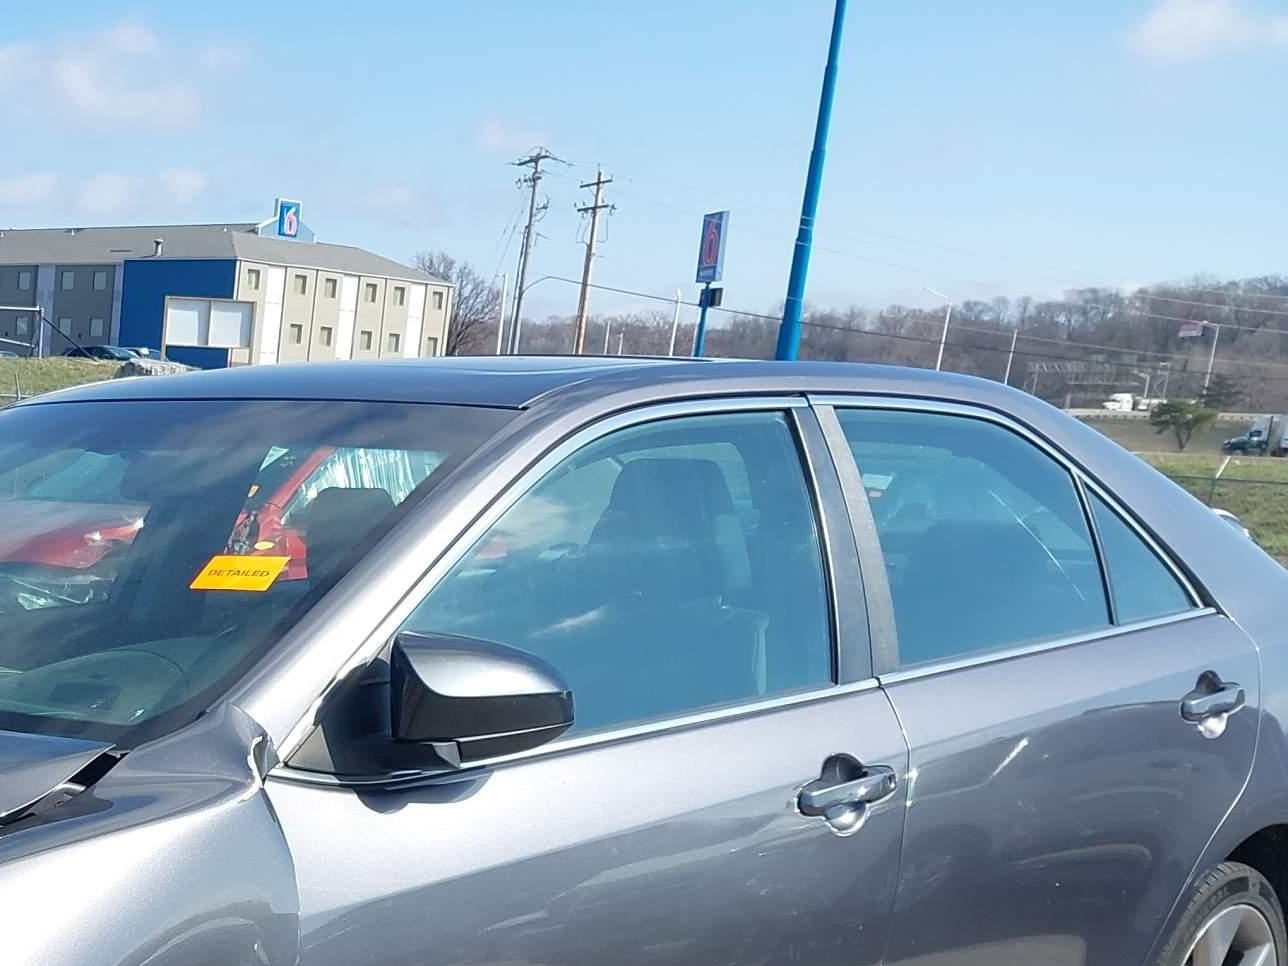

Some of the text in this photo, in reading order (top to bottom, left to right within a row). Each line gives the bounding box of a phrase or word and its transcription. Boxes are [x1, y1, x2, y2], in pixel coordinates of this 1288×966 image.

[284, 206, 297, 236] 6
[703, 220, 718, 266] 6
[207, 569, 270, 577] DETAILED
